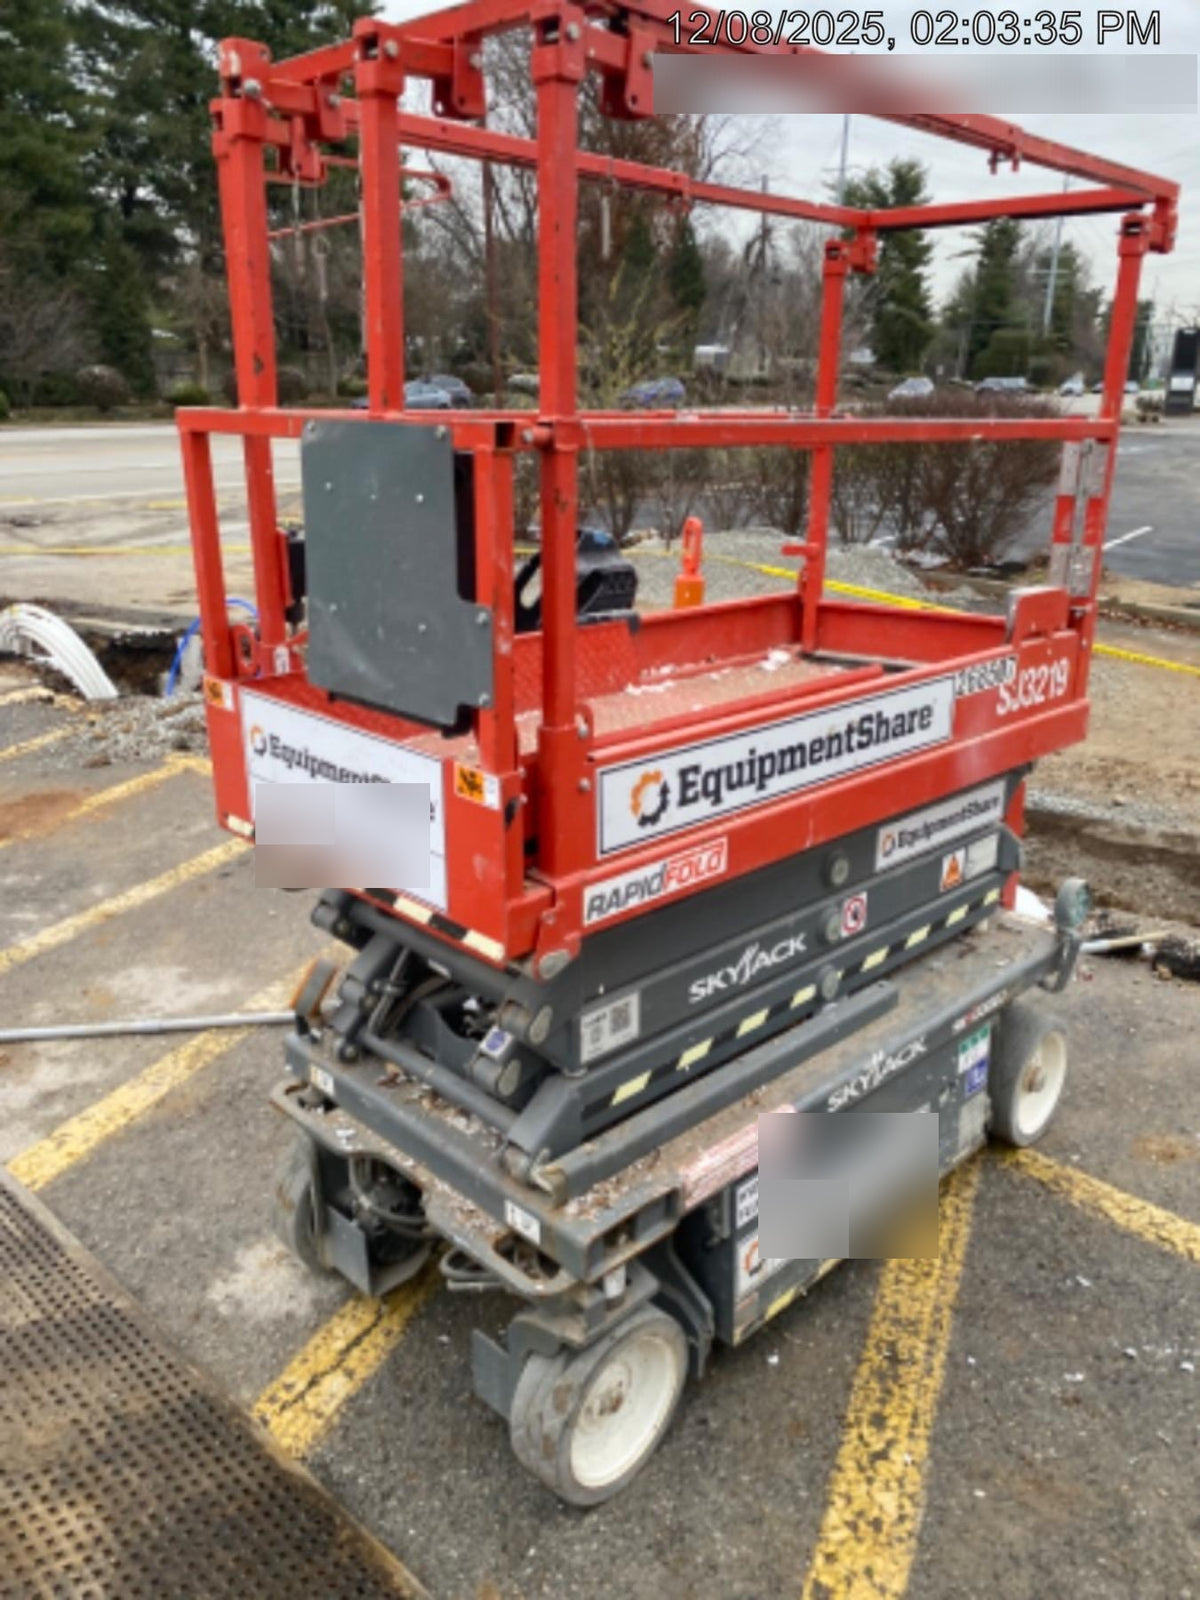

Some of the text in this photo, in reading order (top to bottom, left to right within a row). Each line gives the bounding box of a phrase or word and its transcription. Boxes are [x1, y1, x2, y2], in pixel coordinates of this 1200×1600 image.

[996, 657, 1069, 716] SJ3219
[676, 704, 934, 807] EquipmentShare
[688, 933, 807, 1004] SKYJACK
[828, 1035, 928, 1113] SKYJACK
